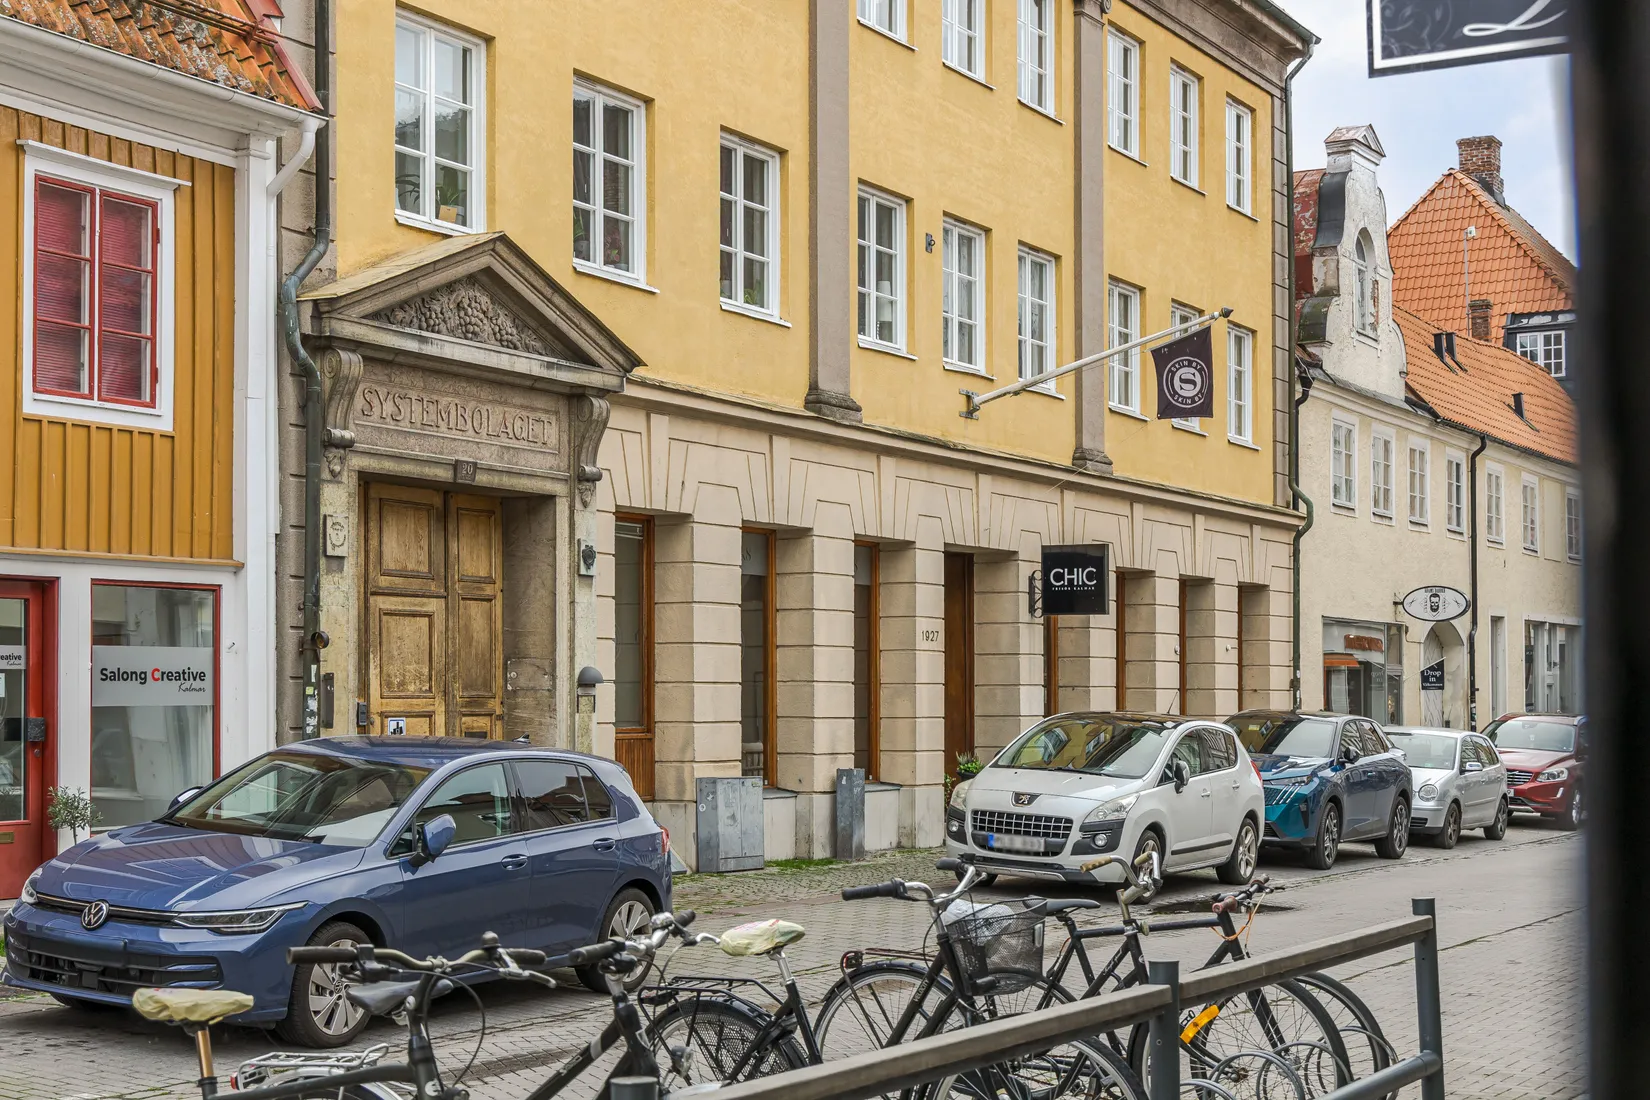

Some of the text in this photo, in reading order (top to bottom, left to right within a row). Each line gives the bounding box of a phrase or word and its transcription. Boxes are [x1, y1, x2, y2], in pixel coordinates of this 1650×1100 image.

[1171, 360, 1202, 372] SKIN BY
[1173, 394, 1192, 404] SKIN
[360, 386, 553, 445] SYSTEMBOLAGET
[461, 462, 473, 475] 20
[1049, 567, 1097, 586] CHIC
[921, 630, 940, 642] 1927
[100, 666, 207, 685] Salong Creative
[1424, 669, 1442, 677] Drop
[178, 682, 207, 693] Kalmar
